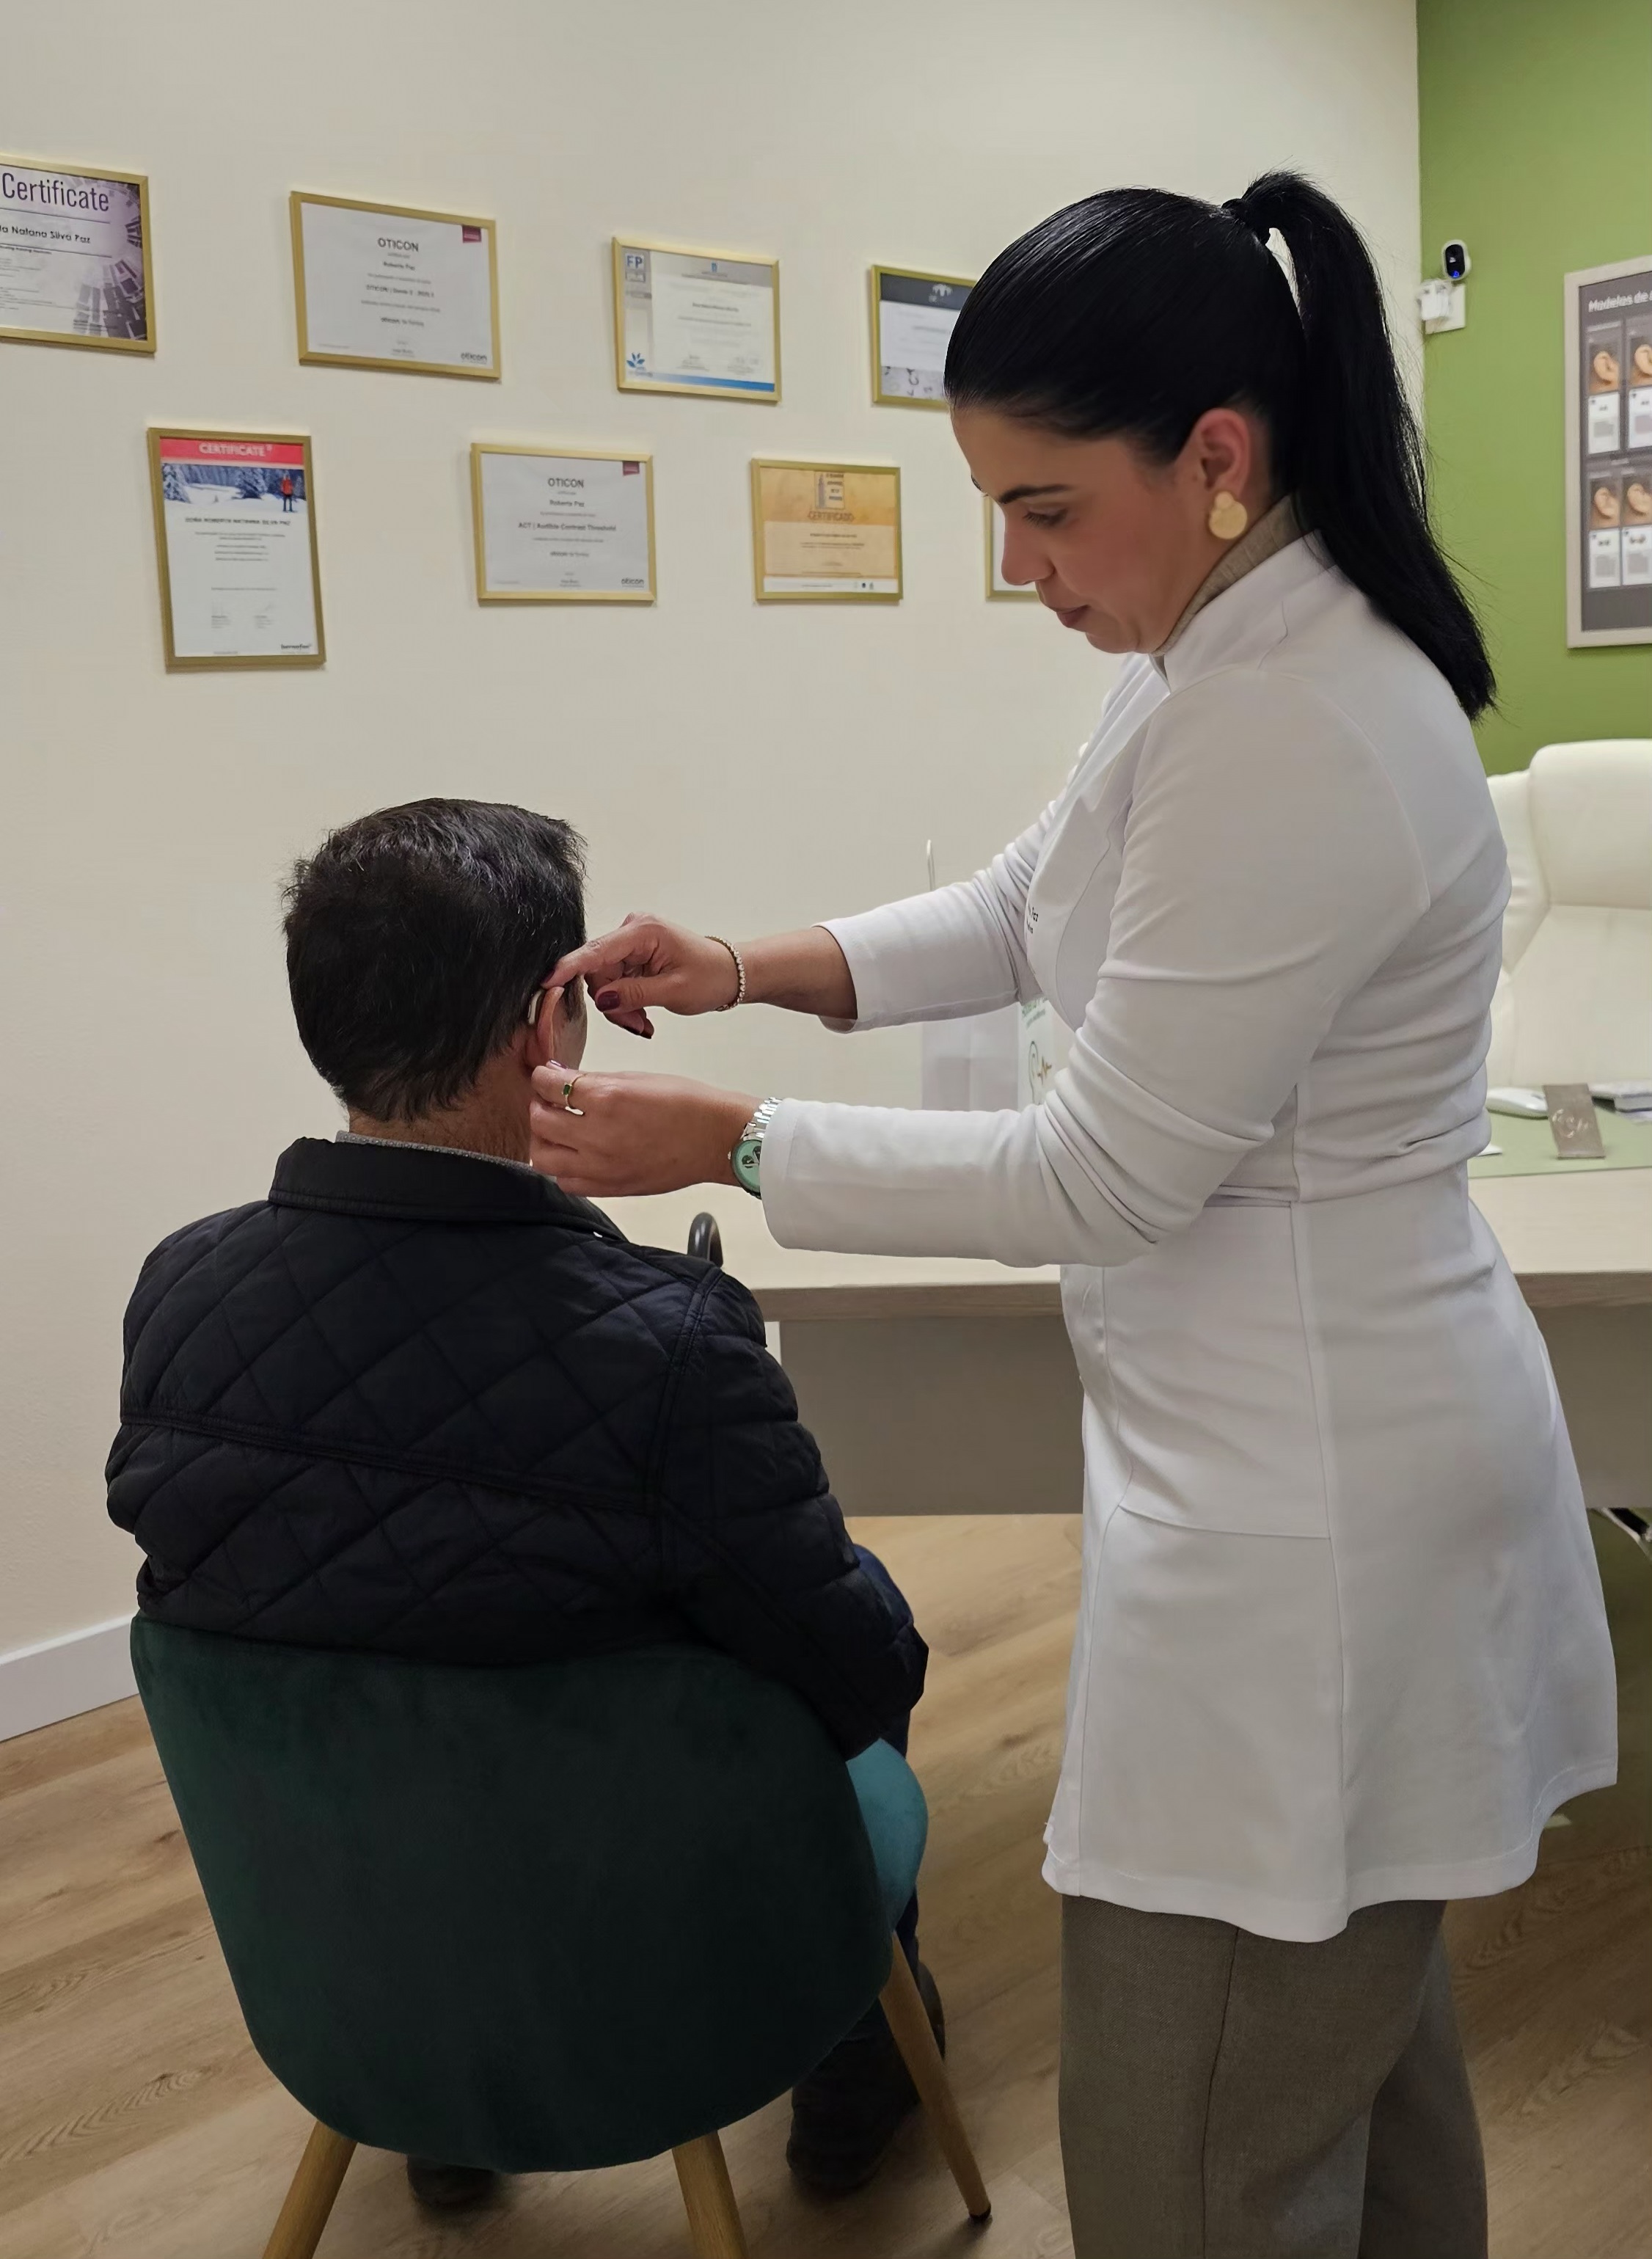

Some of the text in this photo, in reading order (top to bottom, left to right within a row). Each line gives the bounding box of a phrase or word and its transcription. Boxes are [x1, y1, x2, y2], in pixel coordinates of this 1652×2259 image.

[2, 172, 109, 212] Certificate
[50, 230, 72, 241] Silva
[377, 238, 419, 252] OTICON
[627, 255, 643, 269] FP
[1588, 291, 1649, 313] Modelos de
[199, 442, 266, 456] CERTIFICATE
[547, 478, 585, 488] OTICON
